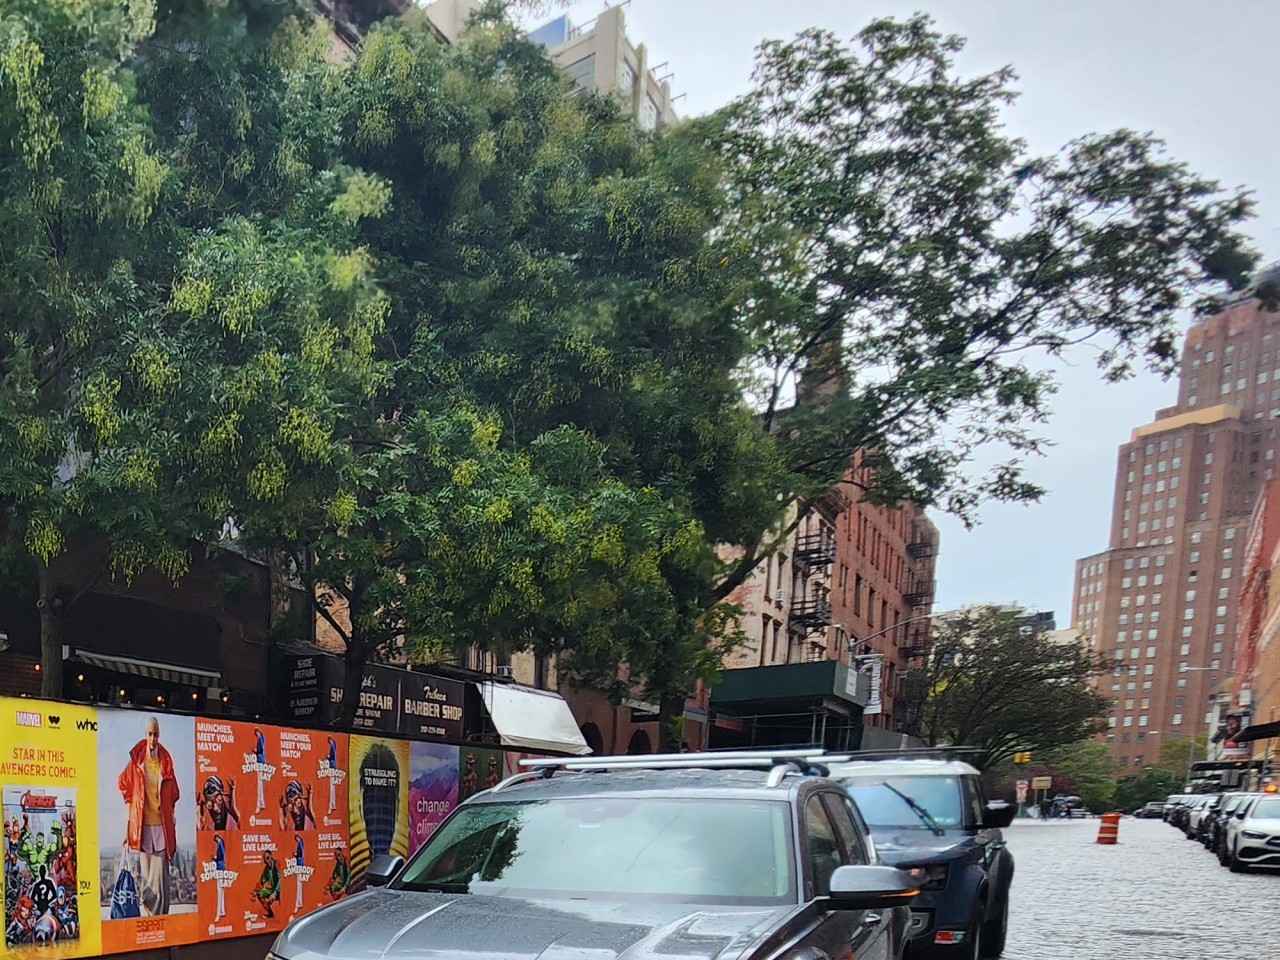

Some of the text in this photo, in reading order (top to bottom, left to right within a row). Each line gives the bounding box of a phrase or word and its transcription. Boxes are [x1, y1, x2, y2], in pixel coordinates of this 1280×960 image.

[294, 668, 316, 679] REPAIR
[359, 692, 393, 711] REPAIR
[294, 707, 314, 716] SHOP
[404, 699, 463, 721] BARBER SHOP
[16, 711, 42, 727] MARVEL
[197, 723, 233, 735] MUNCHIES,
[197, 733, 234, 743] MEET YOUR
[197, 742, 222, 752] MATCH
[280, 741, 311, 751] MEET YOUR
[13, 748, 65, 763] STAR IN THIS
[280, 749, 301, 758] MATCH
[0, 762, 76, 779] AVENGERS COMIC!
[242, 762, 276, 774] SOMEBODY
[364, 768, 397, 778] STRUGGLING
[259, 771, 272, 781] SAY
[317, 768, 346, 779] SOMEBODY
[365, 777, 397, 787] TO MAKE IT?
[417, 797, 450, 816] change
[242, 834, 272, 843] SAVE BIG.
[318, 833, 331, 841] SAVE
[242, 843, 278, 852] LIVE LARGE.
[318, 841, 329, 849] LIVE
[200, 870, 238, 883] SOMEBODY
[283, 865, 314, 878] SOMEBODY
[299, 874, 310, 882] SAY
[79, 879, 91, 890] YOU!
[219, 879, 233, 888] SAY
[136, 919, 165, 932] ESPRIT
